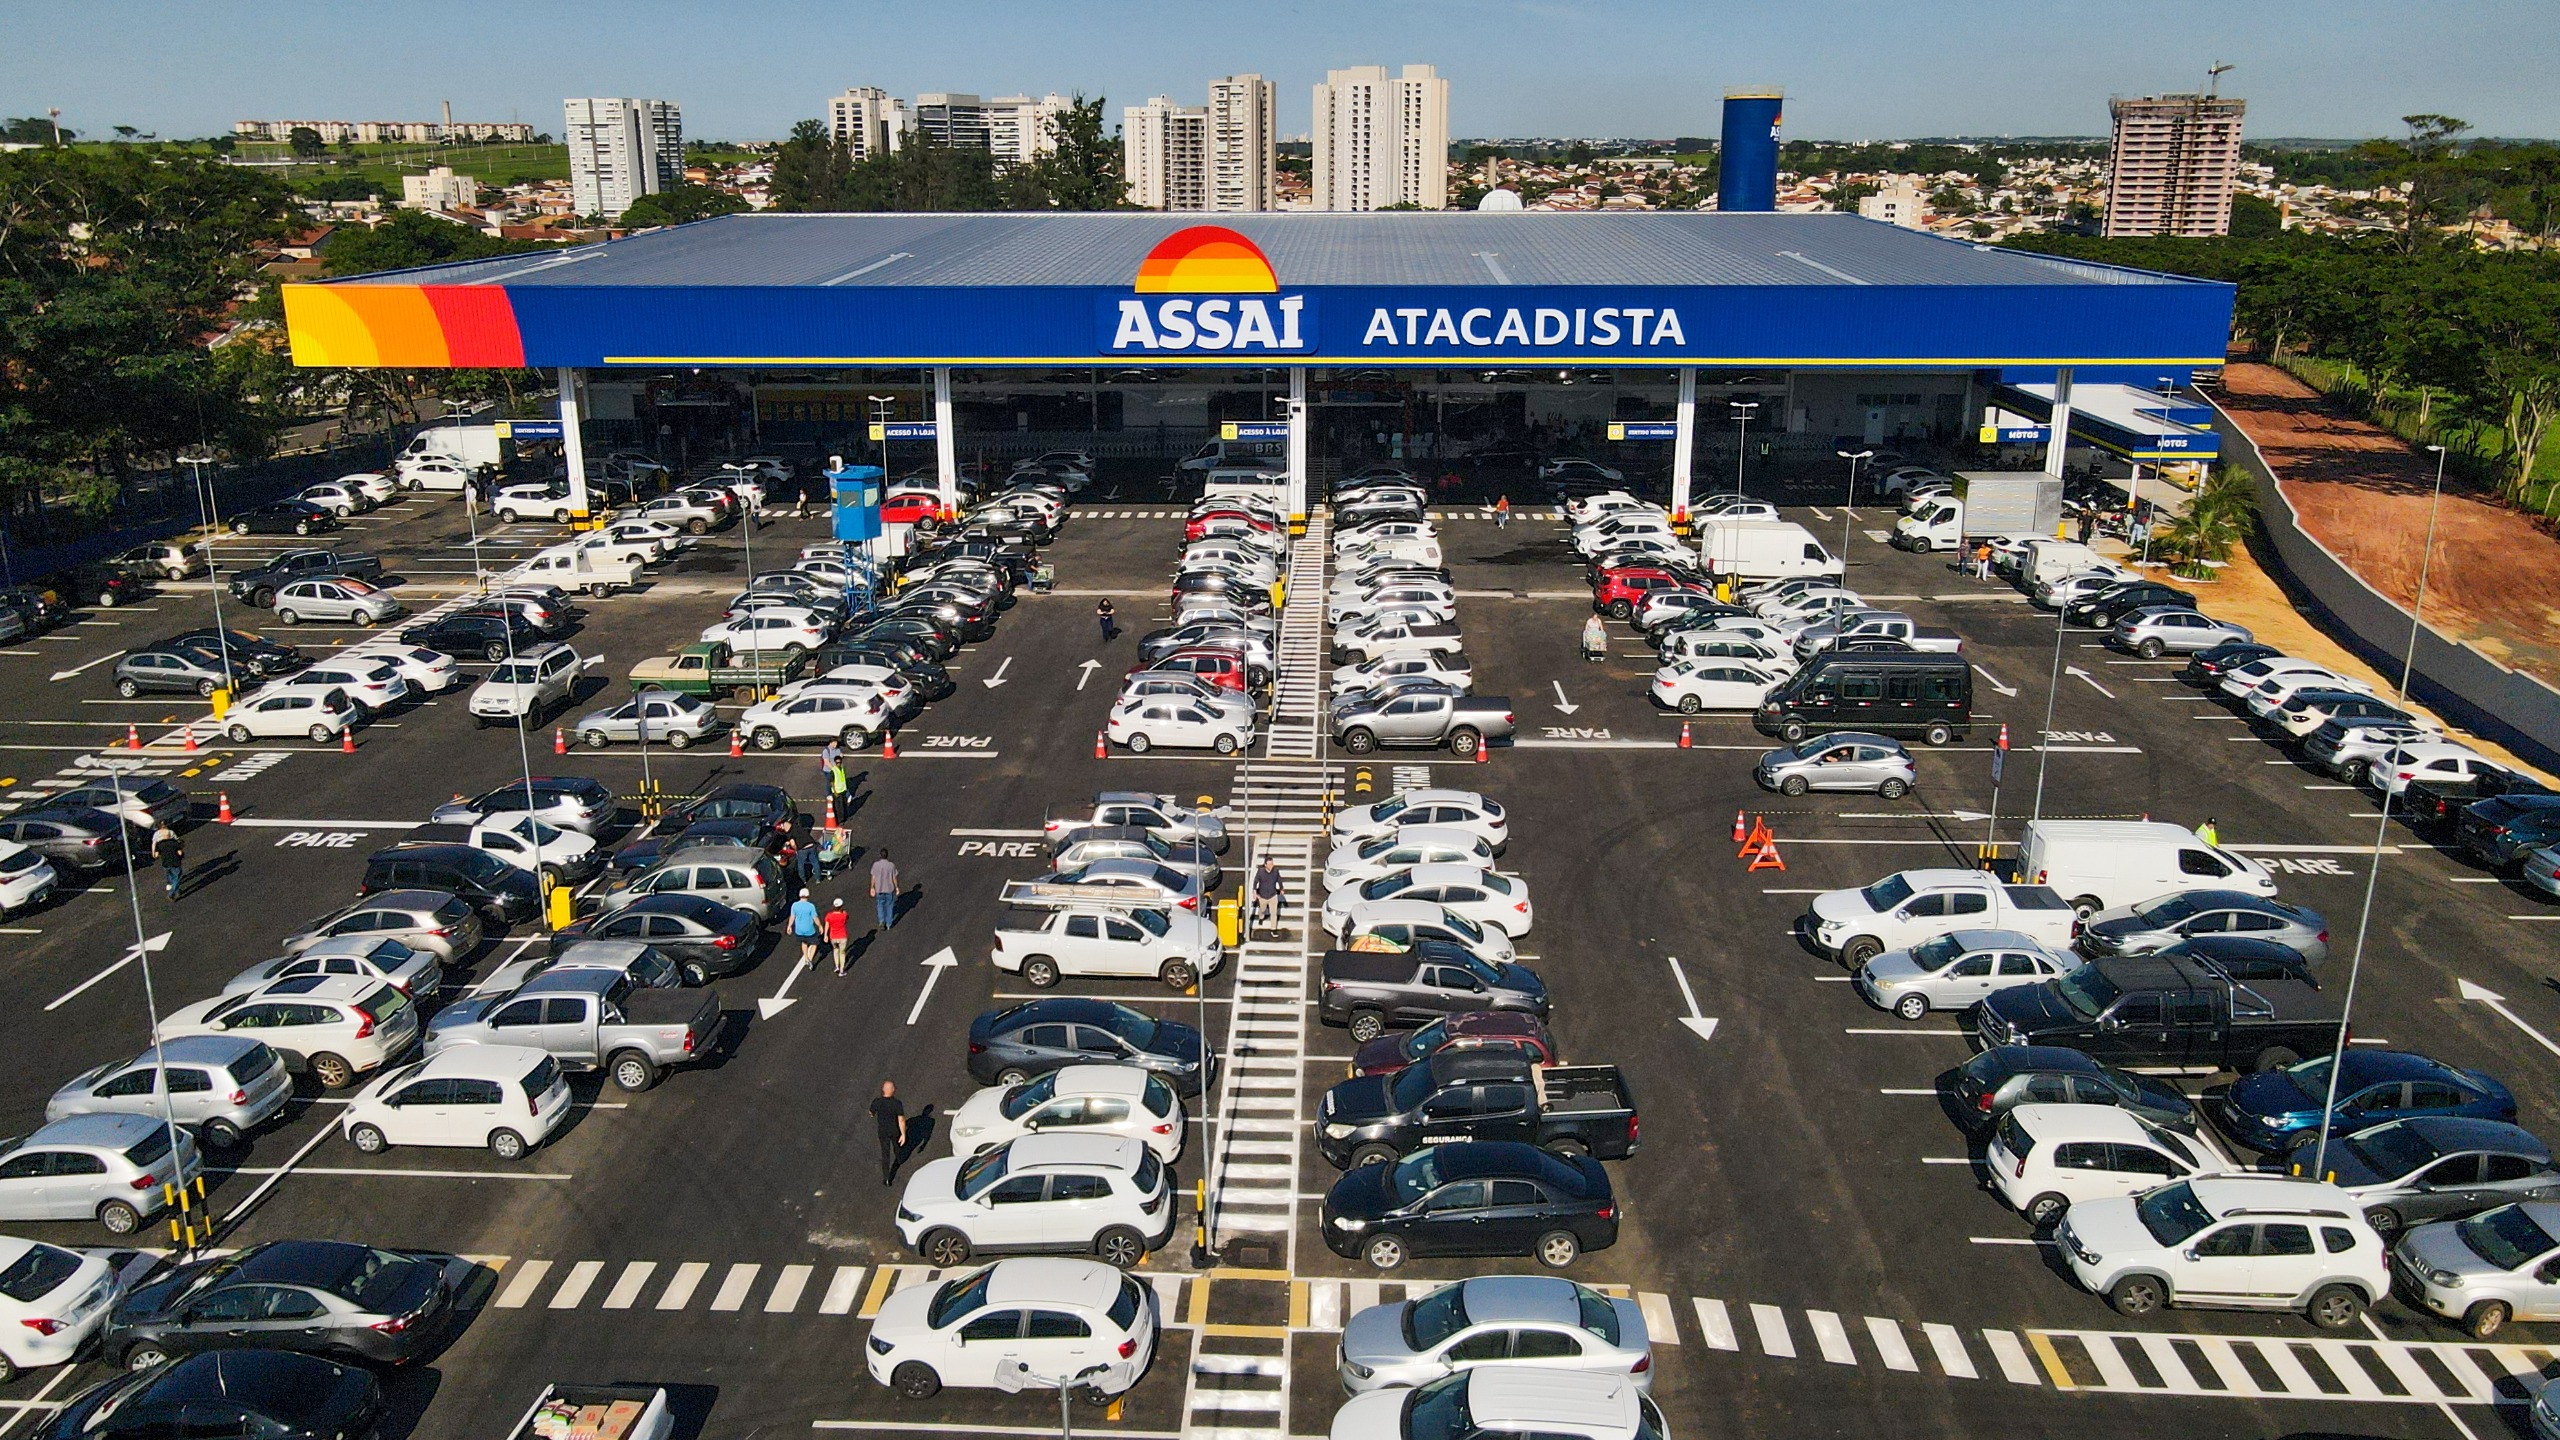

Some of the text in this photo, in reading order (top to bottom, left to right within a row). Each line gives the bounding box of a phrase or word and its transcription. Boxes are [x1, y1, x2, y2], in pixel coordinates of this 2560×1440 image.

[1113, 295, 1686, 350] ASSAÍ ATACADISTA
[913, 428, 918, 436] À
[1266, 427, 1271, 435] À
[2008, 431, 2039, 439] MOTOS
[1540, 727, 1611, 739] PARE
[2036, 730, 2117, 742] PARE
[921, 735, 993, 748] PARE
[274, 831, 369, 848] PARE
[957, 841, 1043, 858] PARE
[2252, 857, 2355, 875] PARE
